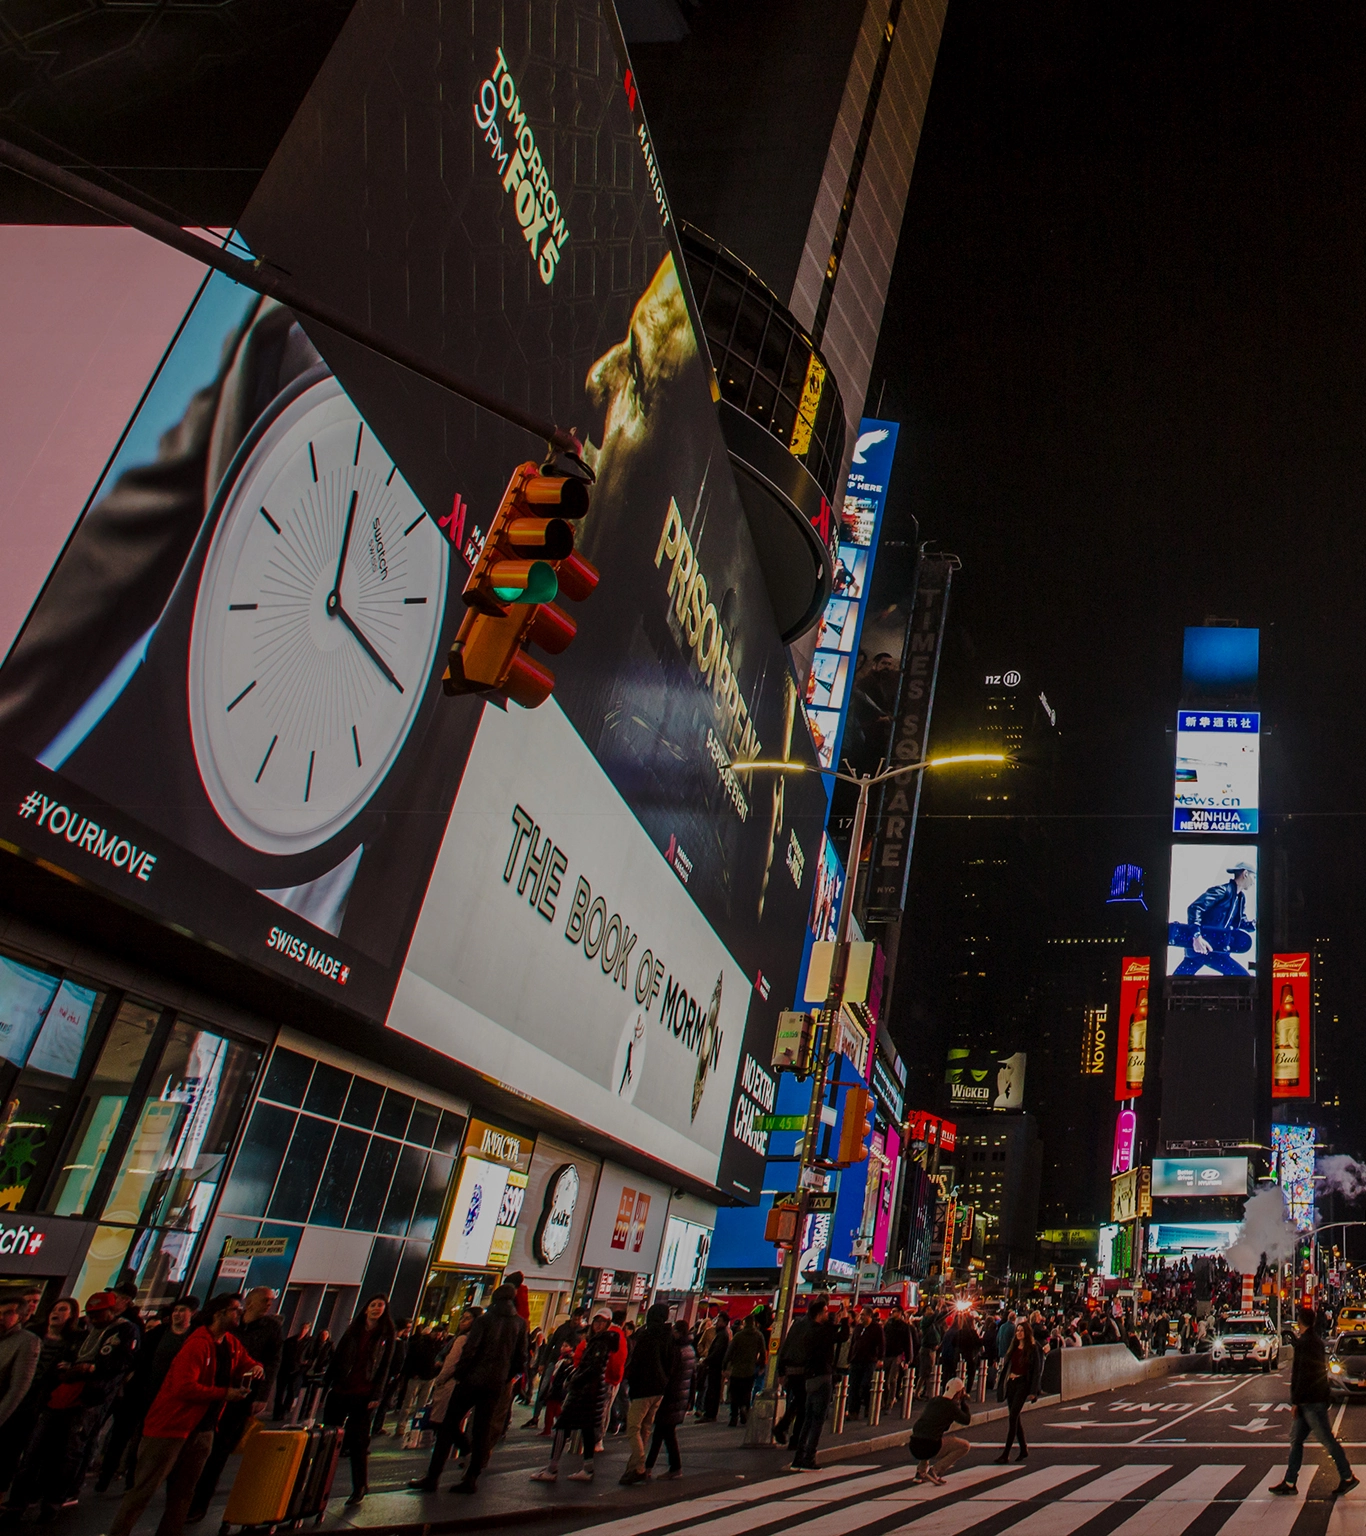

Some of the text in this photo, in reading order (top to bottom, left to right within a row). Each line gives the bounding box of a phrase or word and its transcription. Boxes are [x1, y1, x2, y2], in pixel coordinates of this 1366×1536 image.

[492, 47, 570, 250] TOMORROW
[636, 123, 671, 228] MARRIOTT
[502, 148, 561, 285] FOX 5
[857, 482, 883, 493] HERE
[371, 516, 389, 582] swatch
[653, 495, 724, 688] PRISON
[908, 588, 941, 701] TIMES
[730, 780, 749, 823] EVENT
[880, 714, 919, 868] SQUARE
[1191, 810, 1242, 823] XINHUA
[18, 790, 158, 882] #YOURMOVE
[1180, 821, 1252, 831] NEWS AGENCY
[502, 803, 569, 923] THE
[876, 885, 897, 894] NYC
[266, 926, 342, 980] SWISS MADE
[564, 874, 665, 1012] BOOK OF
[1091, 1003, 1108, 1074] NOVOTEL
[741, 1052, 776, 1114] NO EXTRA
[951, 1083, 990, 1099] WICKED
[480, 1129, 521, 1163] INVICTA
[765, 1117, 792, 1129] W 45
[872, 1296, 892, 1304] VIEW
